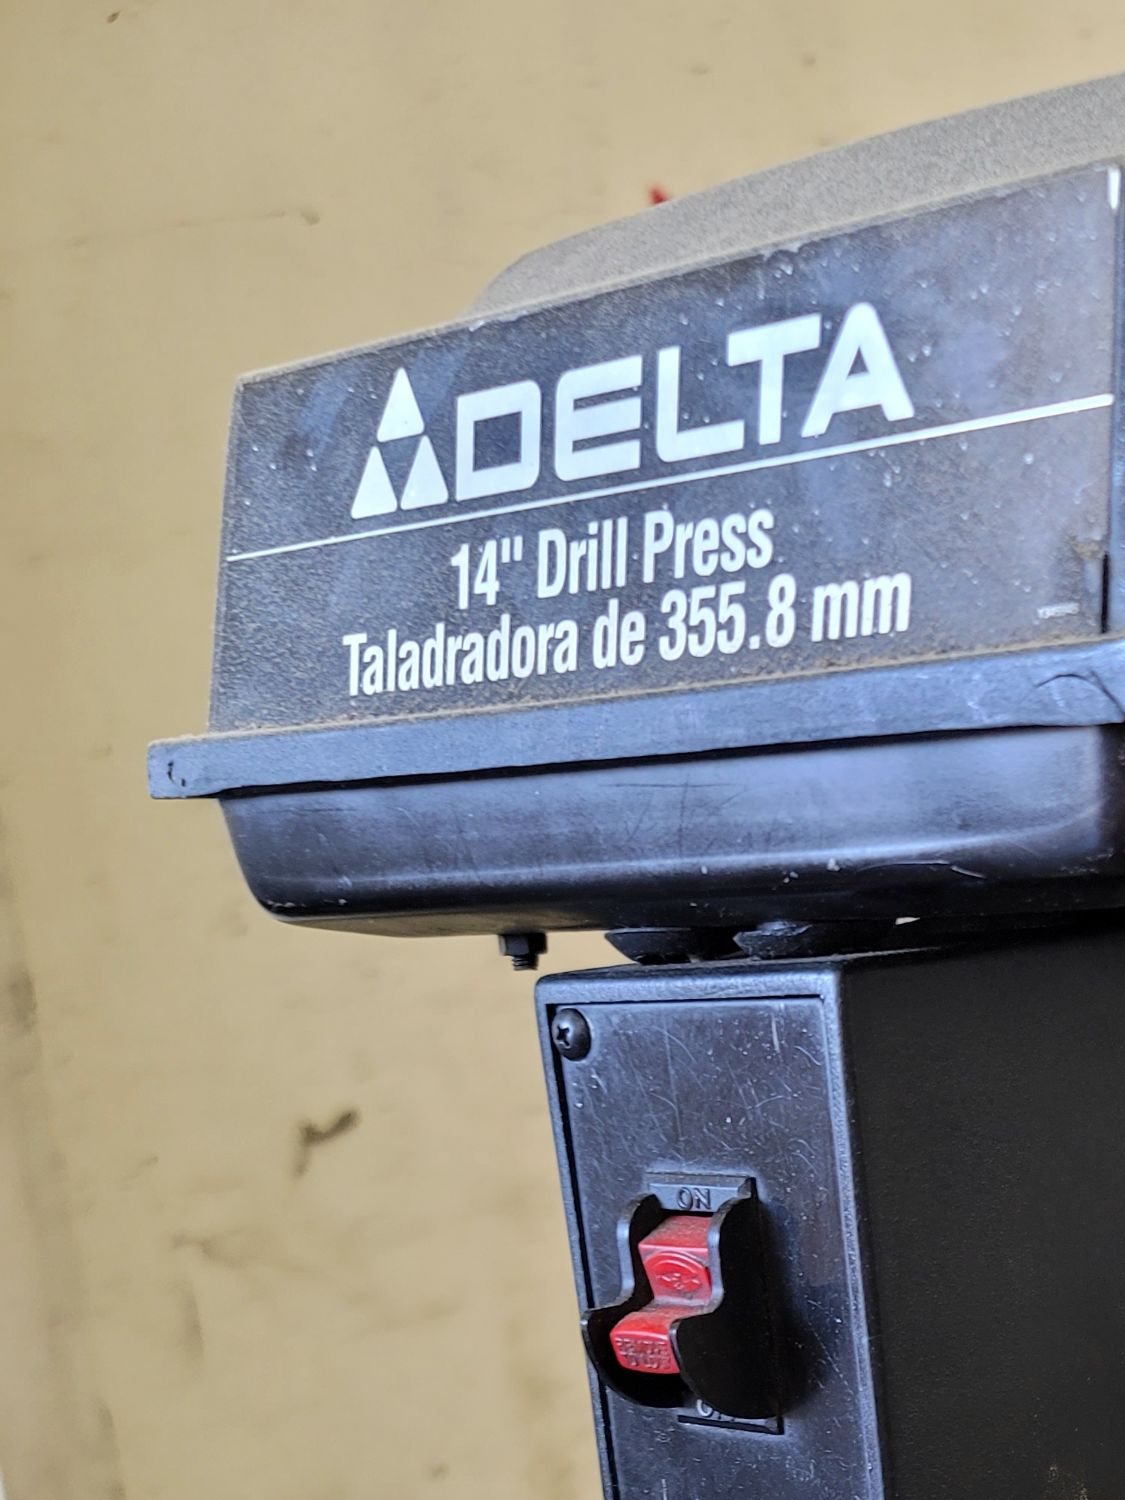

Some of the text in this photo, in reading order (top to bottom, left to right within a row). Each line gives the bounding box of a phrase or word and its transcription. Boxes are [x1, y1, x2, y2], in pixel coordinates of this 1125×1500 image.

[455, 302, 916, 502] DELTA
[450, 508, 775, 609] 14" Drill Press
[343, 572, 912, 696] Taladradora de 355.8 mm
[677, 1187, 711, 1210] ON
